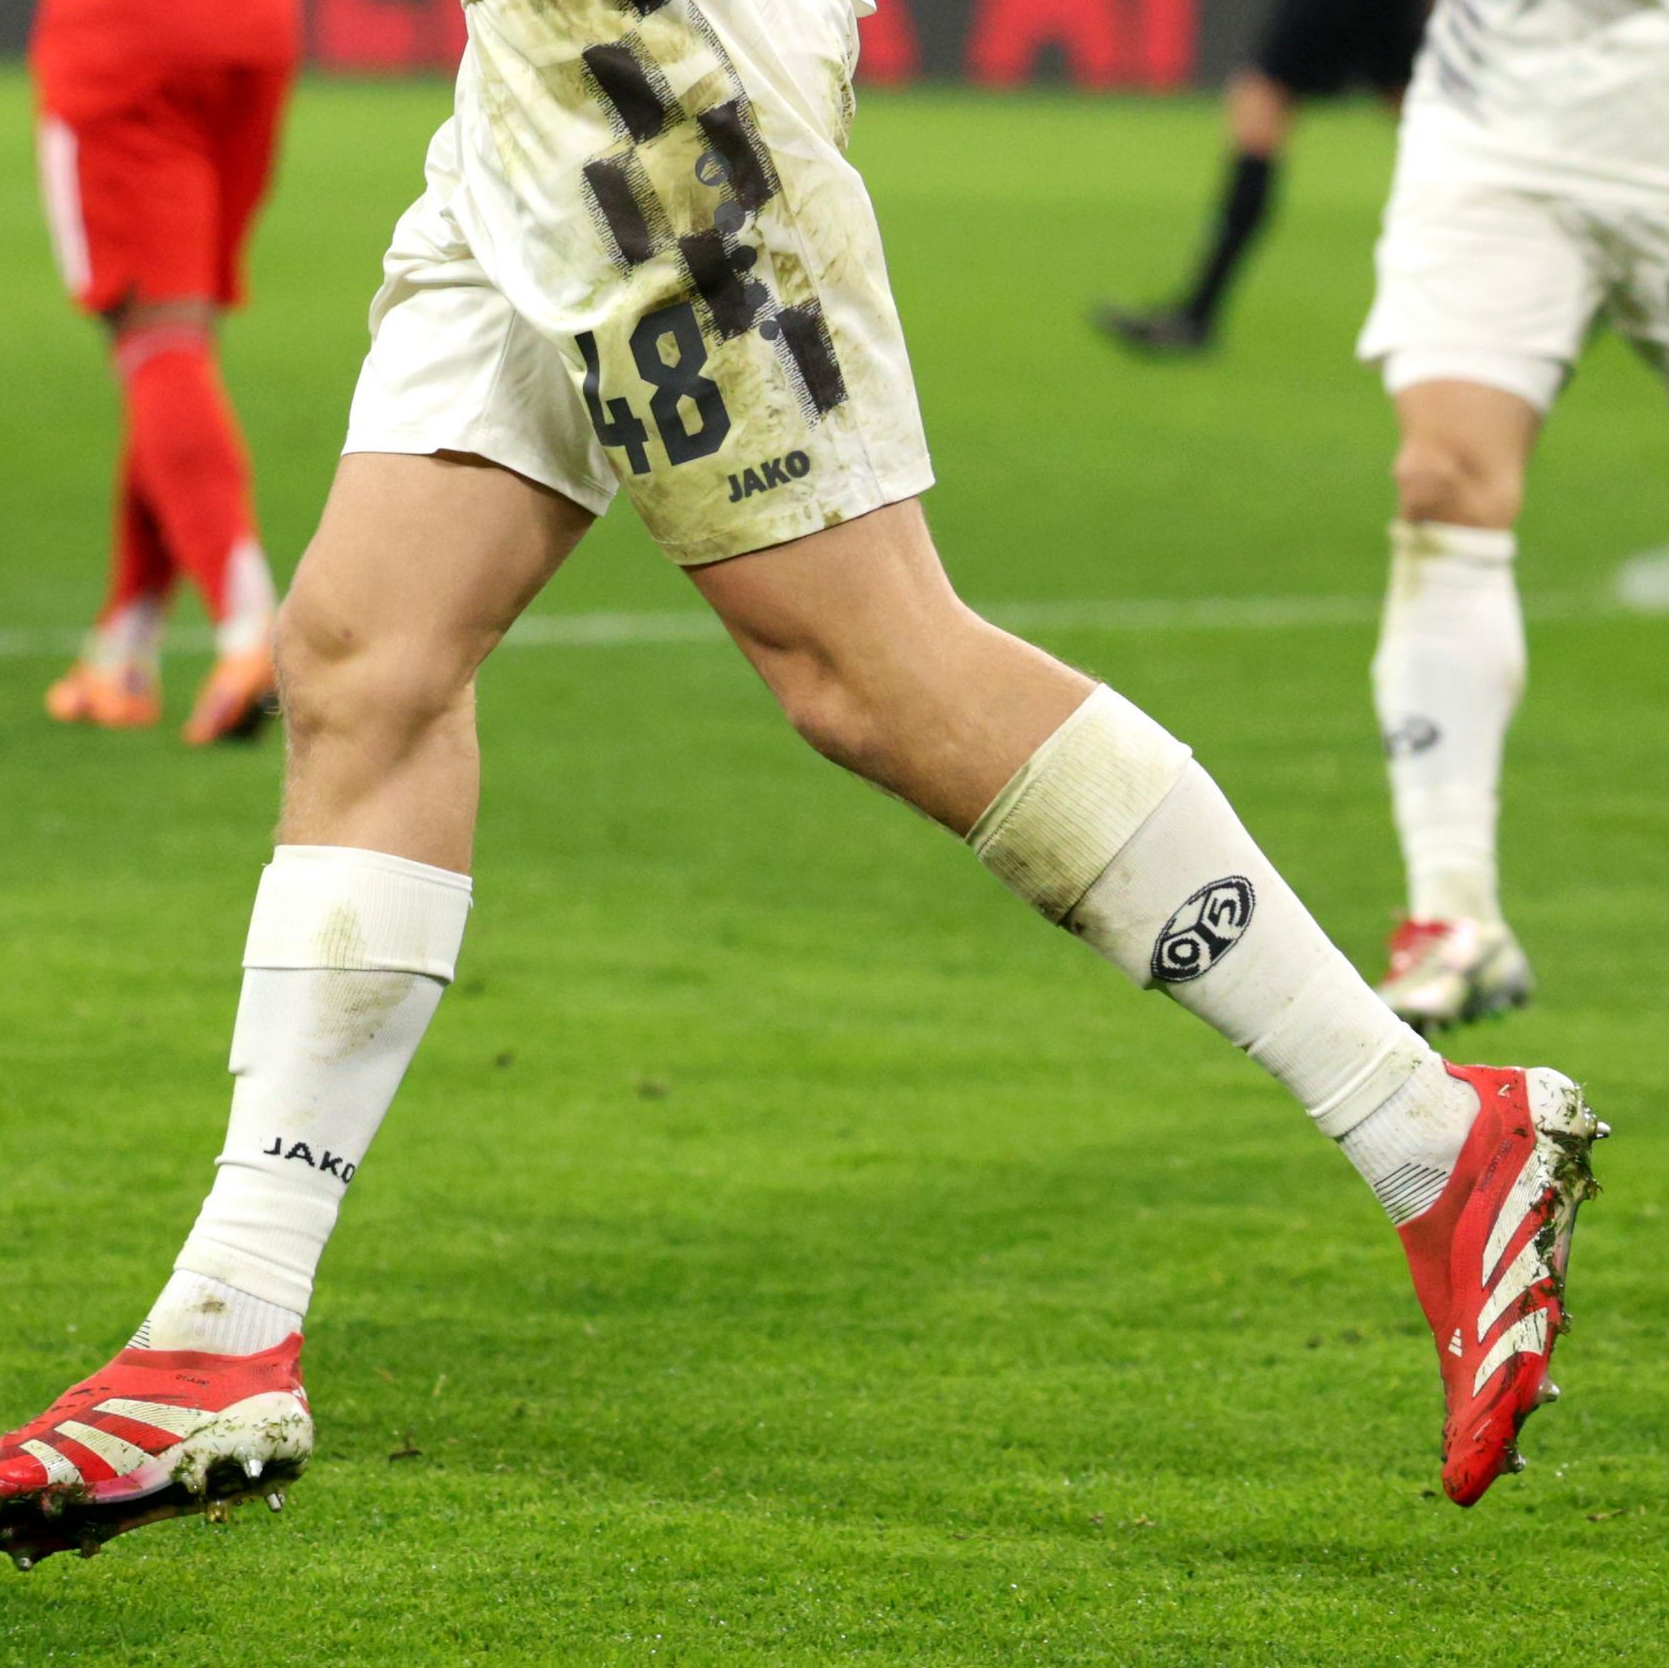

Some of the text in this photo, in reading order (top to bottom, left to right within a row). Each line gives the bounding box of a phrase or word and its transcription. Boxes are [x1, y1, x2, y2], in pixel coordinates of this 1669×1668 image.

[574, 300, 732, 476] 48
[726, 449, 811, 503] JAKO
[263, 1137, 356, 1184] JAKO
